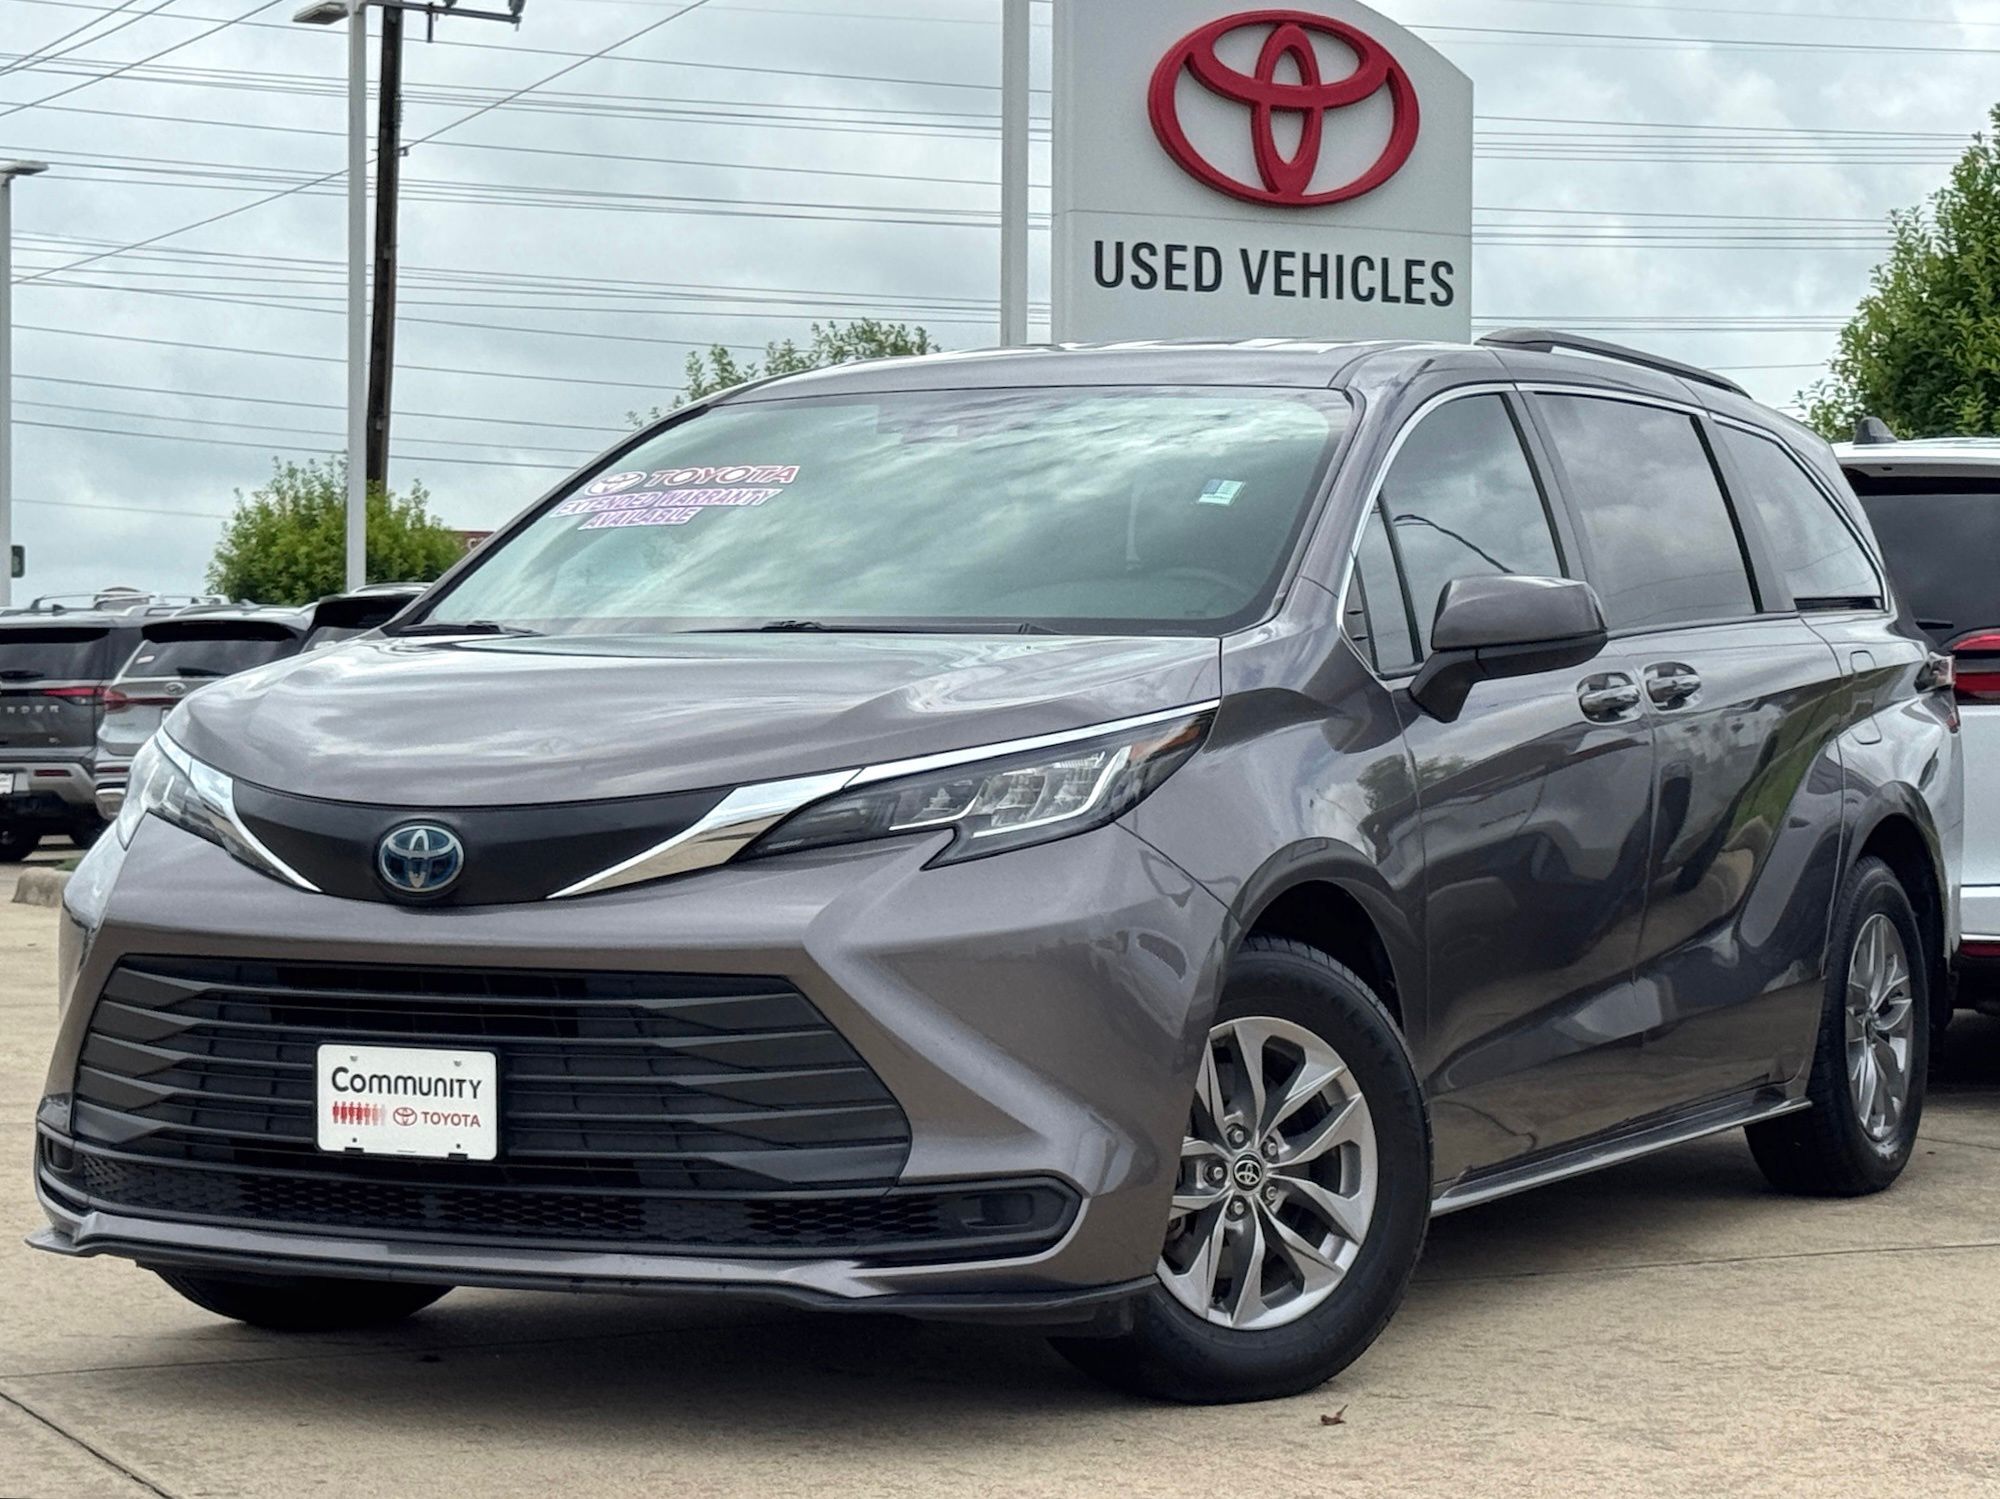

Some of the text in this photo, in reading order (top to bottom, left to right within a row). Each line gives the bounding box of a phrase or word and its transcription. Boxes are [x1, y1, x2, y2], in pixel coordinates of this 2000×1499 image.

[1094, 239, 1455, 308] USED VEHICLES
[645, 466, 799, 487] TOYOTA
[421, 1111, 482, 1128] TOYOTA
